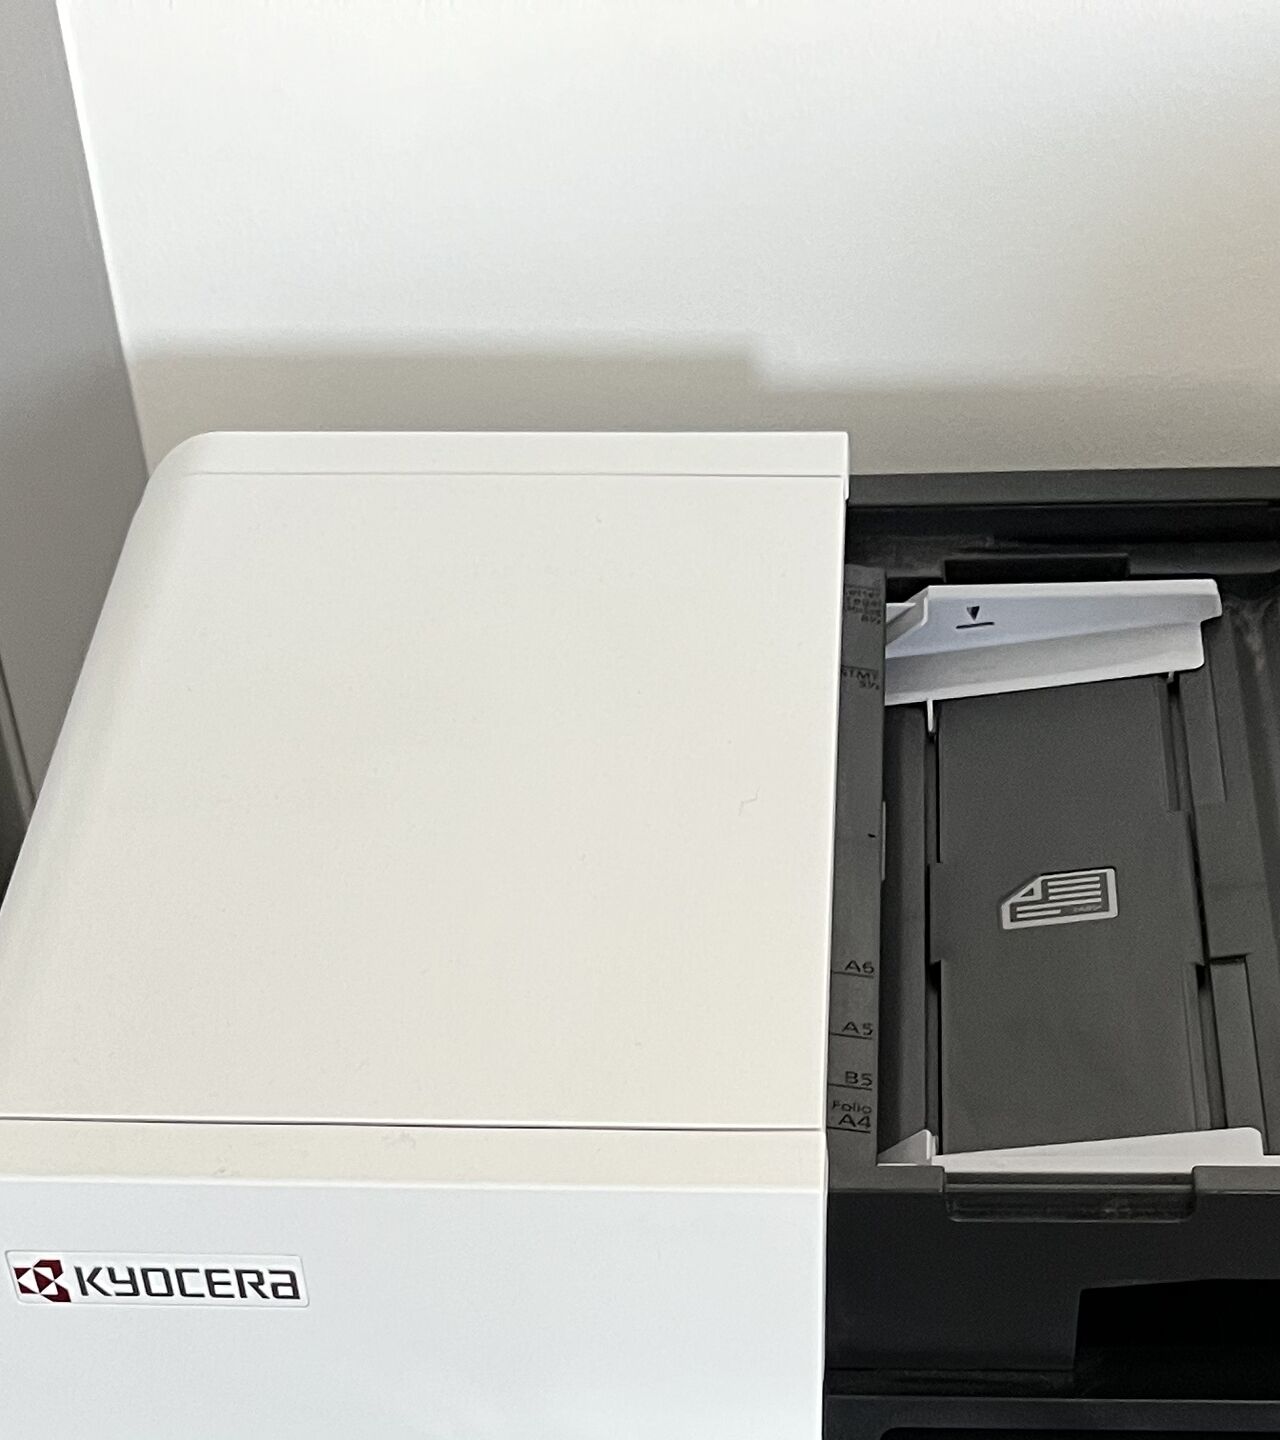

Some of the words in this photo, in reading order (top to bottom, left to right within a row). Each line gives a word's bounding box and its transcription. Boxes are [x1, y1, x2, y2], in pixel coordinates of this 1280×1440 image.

[842, 1021, 873, 1036] A5
[844, 1071, 873, 1087] B5
[837, 1113, 872, 1129] A4
[74, 1265, 301, 1300] KYOCERA
